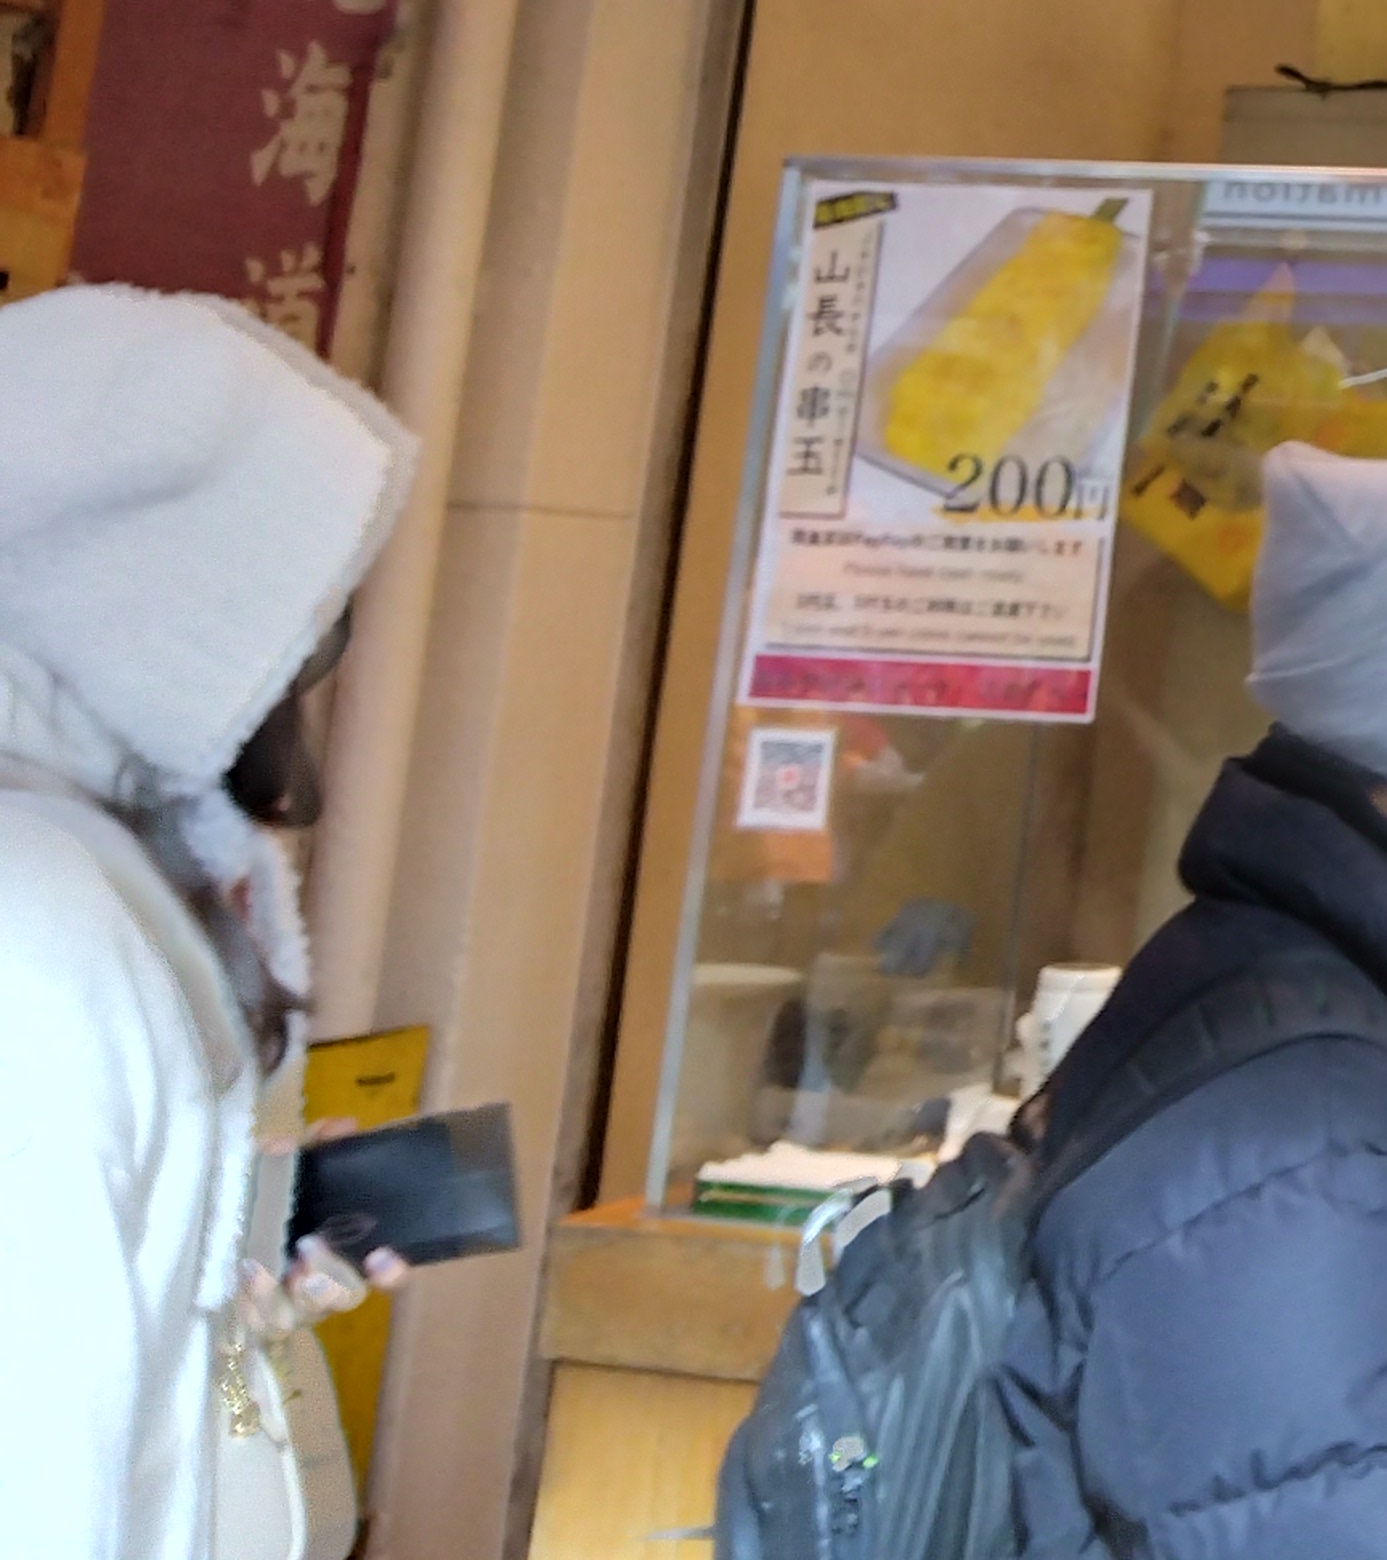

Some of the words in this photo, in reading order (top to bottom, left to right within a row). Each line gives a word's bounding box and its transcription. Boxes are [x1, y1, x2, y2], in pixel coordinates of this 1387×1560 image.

[785, 248, 852, 477] 山長の串玉
